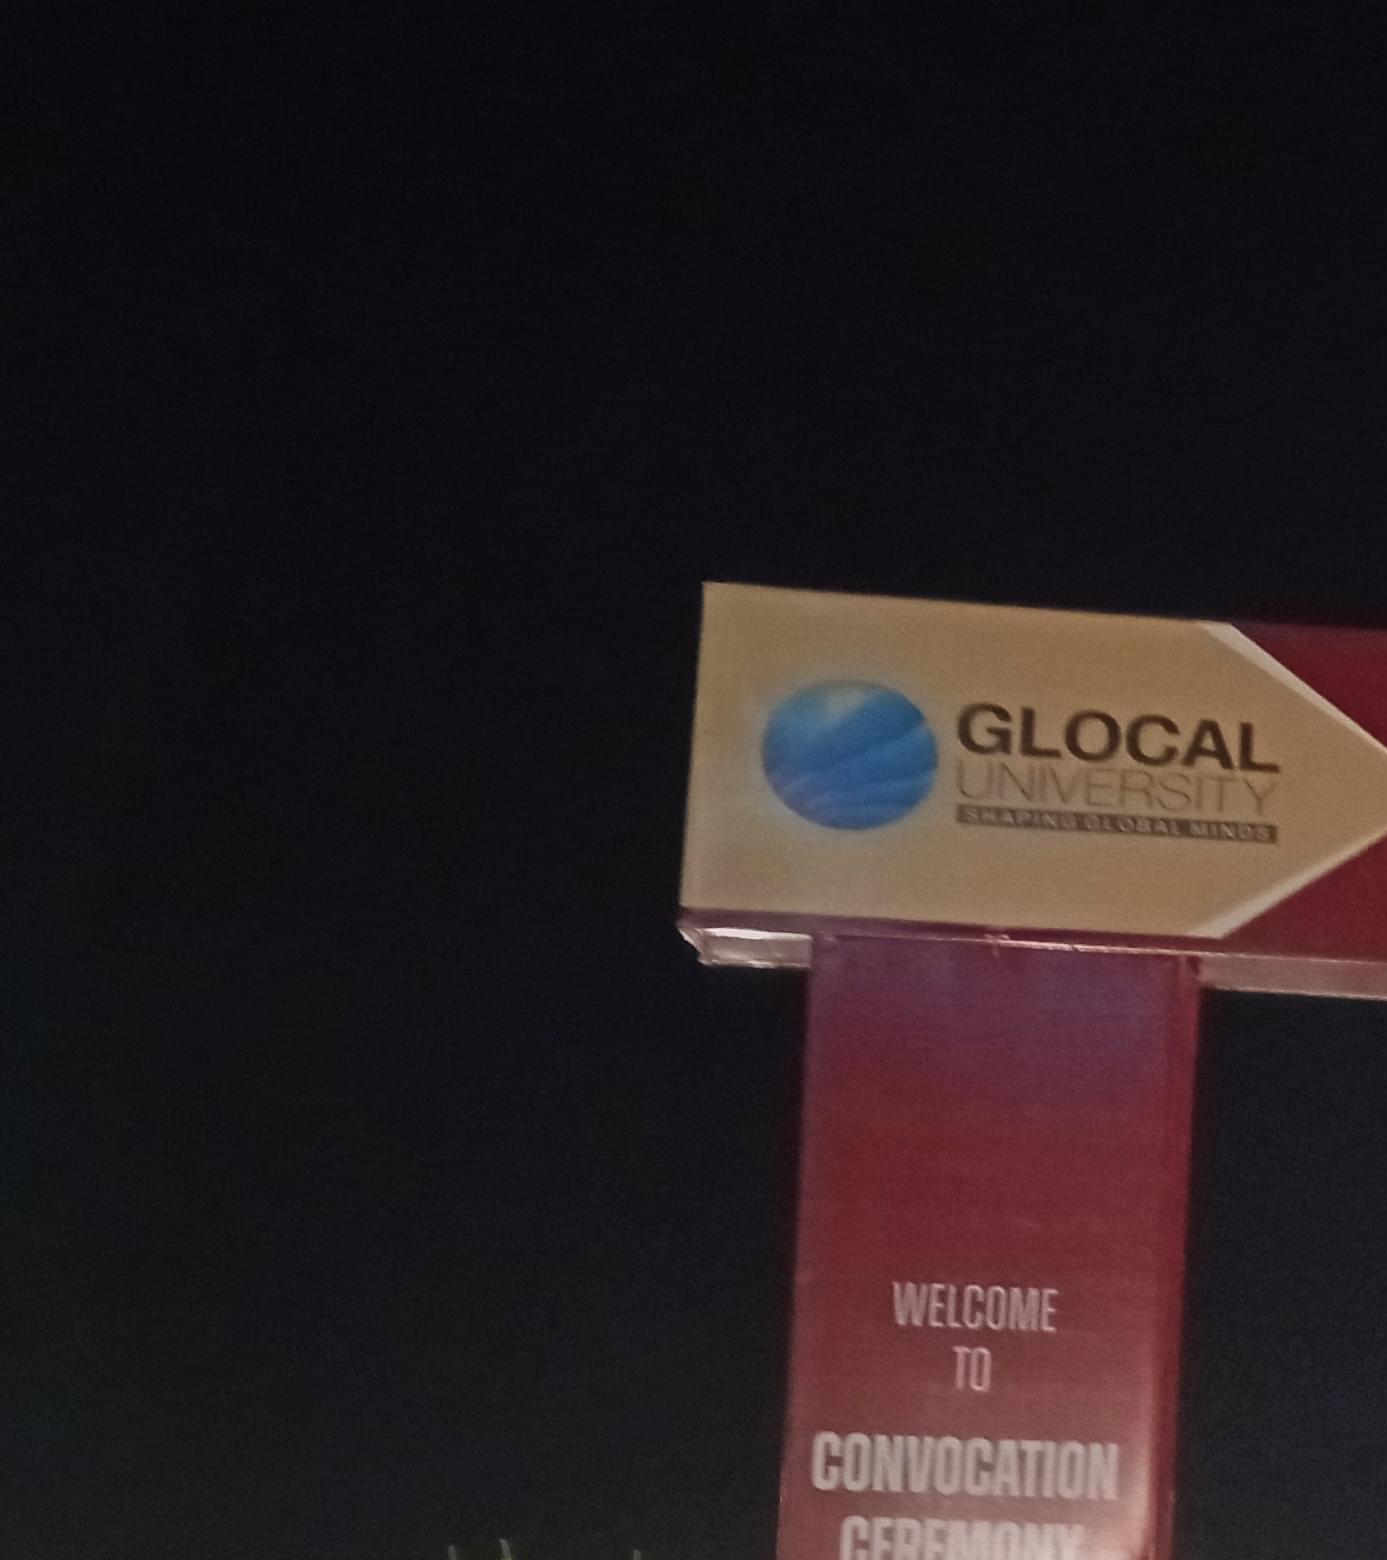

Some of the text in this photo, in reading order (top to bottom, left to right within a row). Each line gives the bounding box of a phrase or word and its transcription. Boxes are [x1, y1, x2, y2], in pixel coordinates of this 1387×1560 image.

[957, 702, 1280, 773] GLOCAL
[956, 760, 1279, 815] UNIVERSITY
[964, 807, 1272, 842] SHAPING GLOBAL MINDS
[892, 1282, 1059, 1333] WELCOME
[952, 1345, 993, 1392] TO
[811, 1431, 1119, 1500] CONVOCATION
